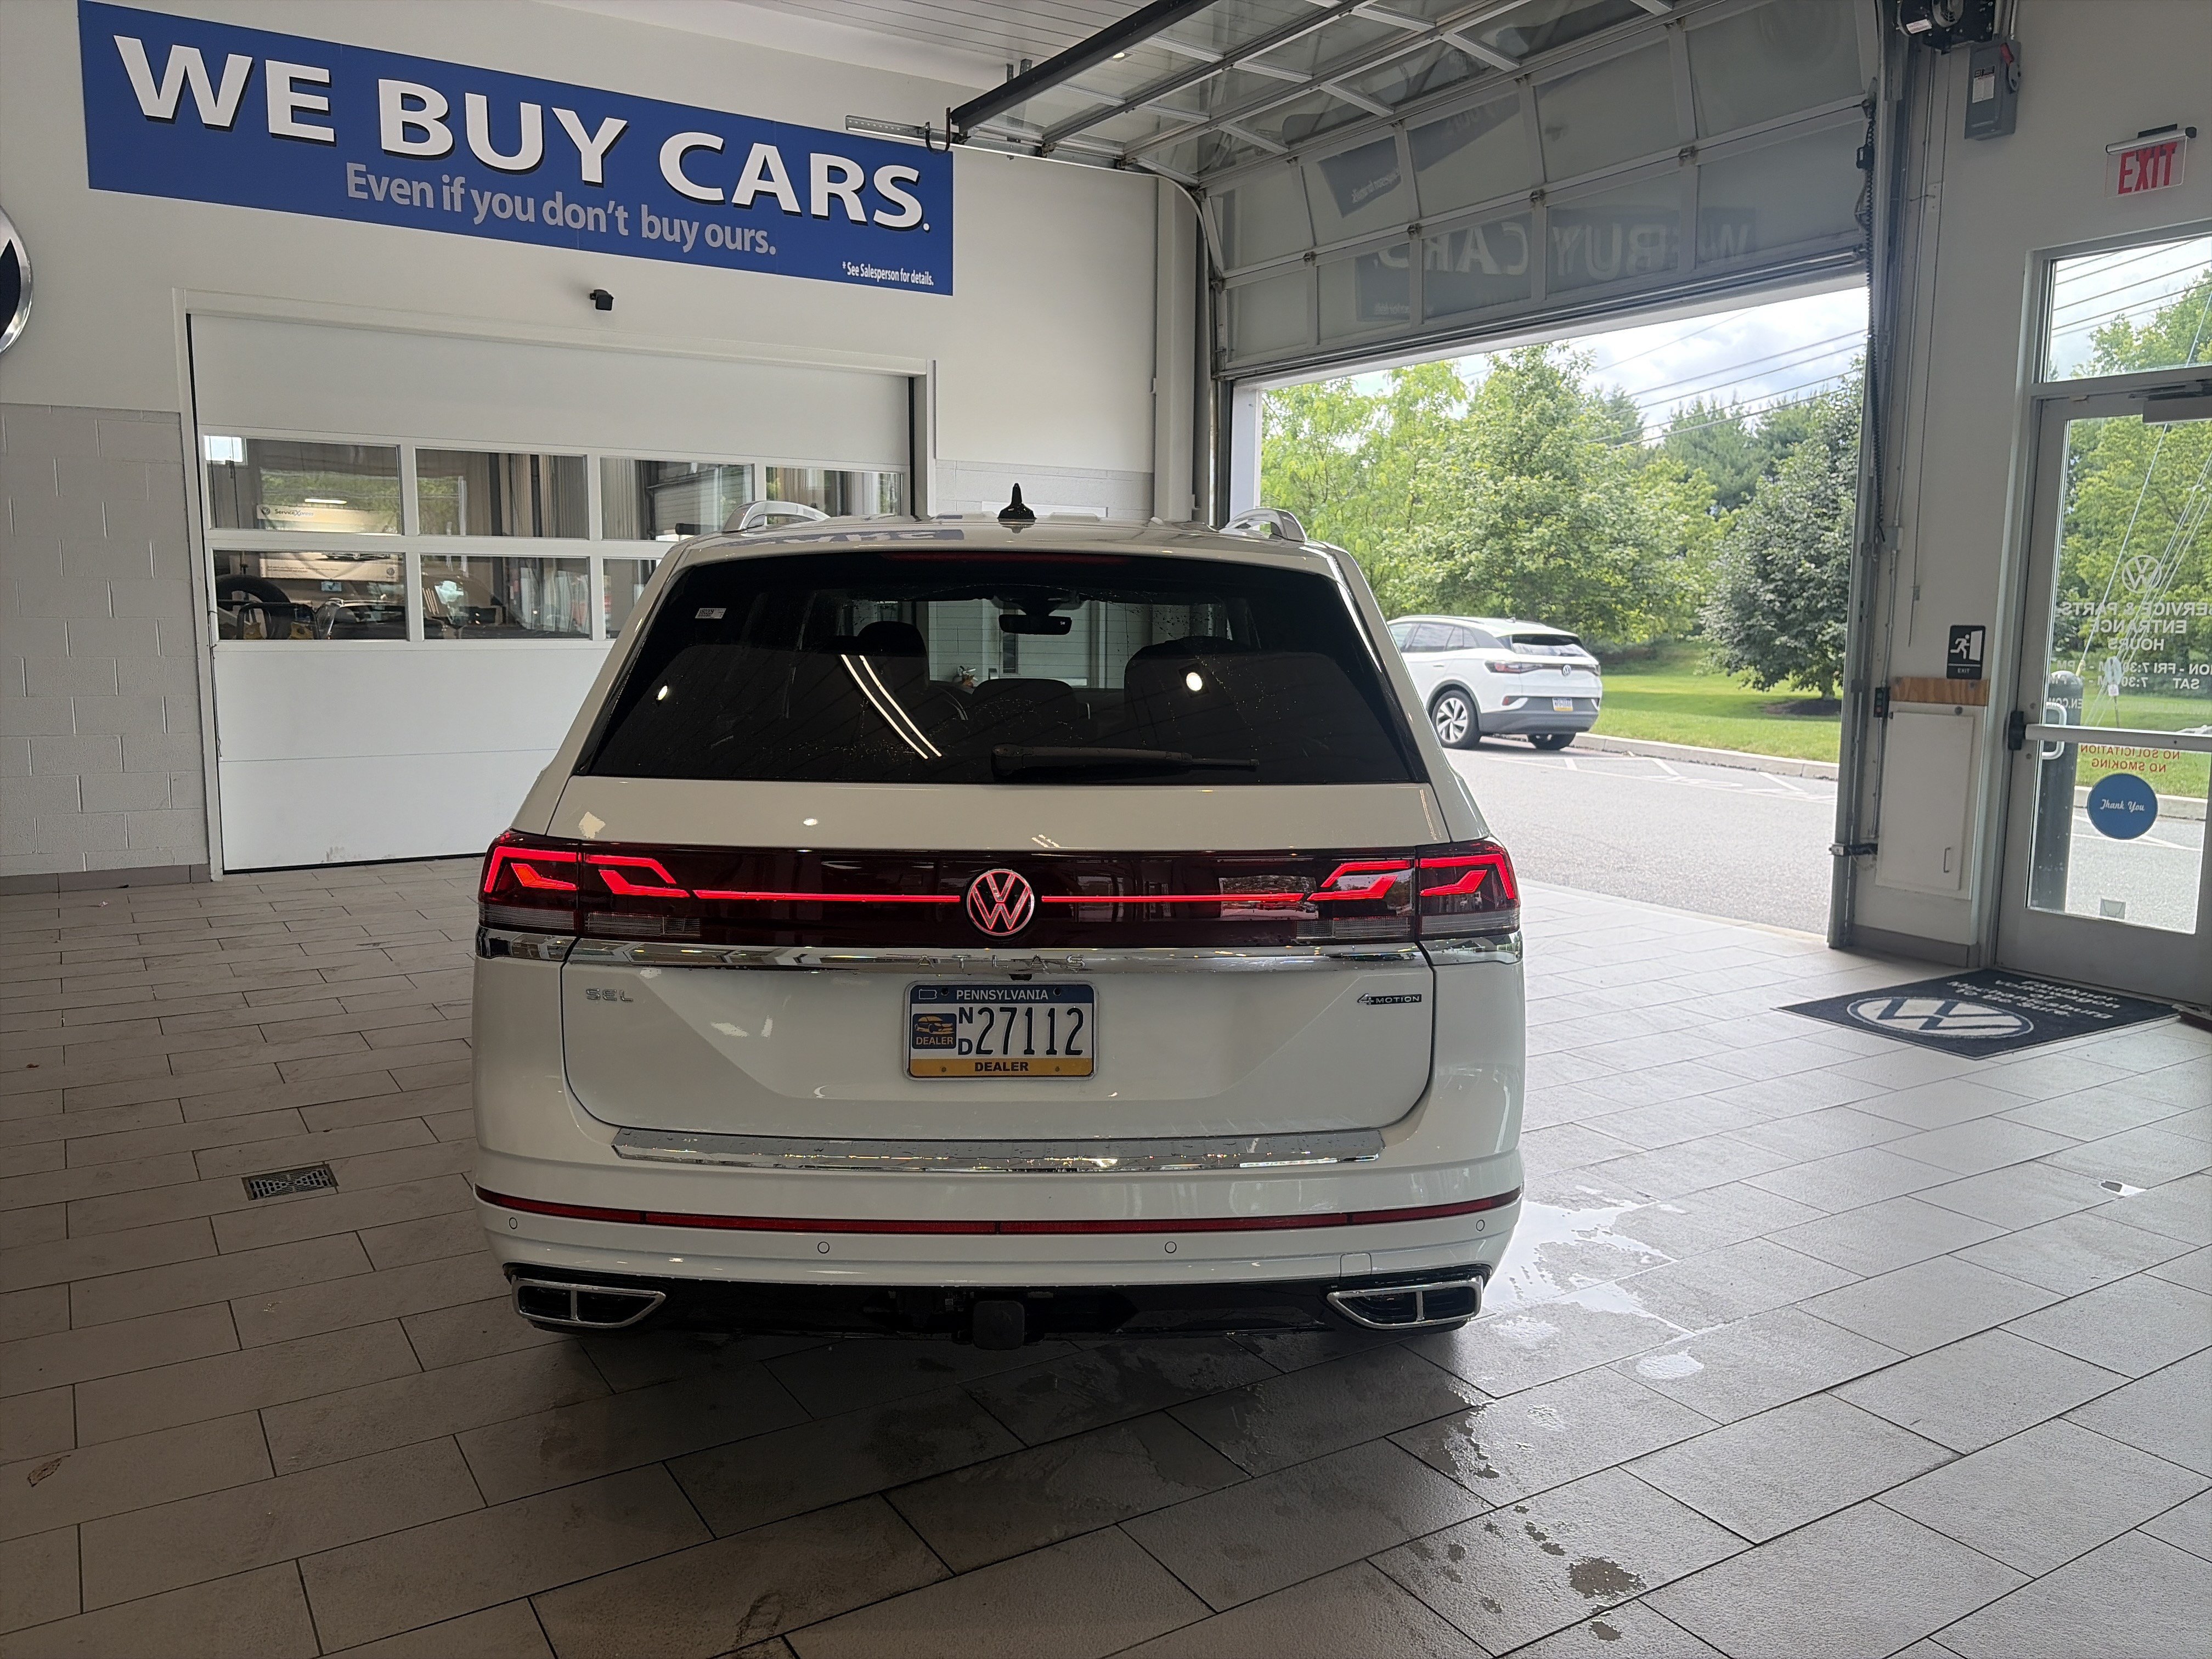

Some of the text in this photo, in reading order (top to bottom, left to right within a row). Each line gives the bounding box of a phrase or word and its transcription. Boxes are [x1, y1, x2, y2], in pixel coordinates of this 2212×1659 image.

[113, 34, 336, 145] WE
[377, 78, 629, 185] BUY
[2118, 142, 2177, 194] EXIT
[346, 162, 777, 256] Even if you don't buy ours.
[860, 263, 900, 283] Salesperson
[900, 268, 910, 283] for
[910, 269, 934, 286] details.
[2100, 798, 2146, 813] Thank You
[916, 953, 1086, 971] ATLAS
[585, 989, 634, 1003] SEL
[956, 989, 1049, 1001] PENNSYLVANIA
[975, 1007, 1085, 1056] 27112
[916, 1036, 953, 1046] DEALER
[974, 1061, 1029, 1072] DEALER
